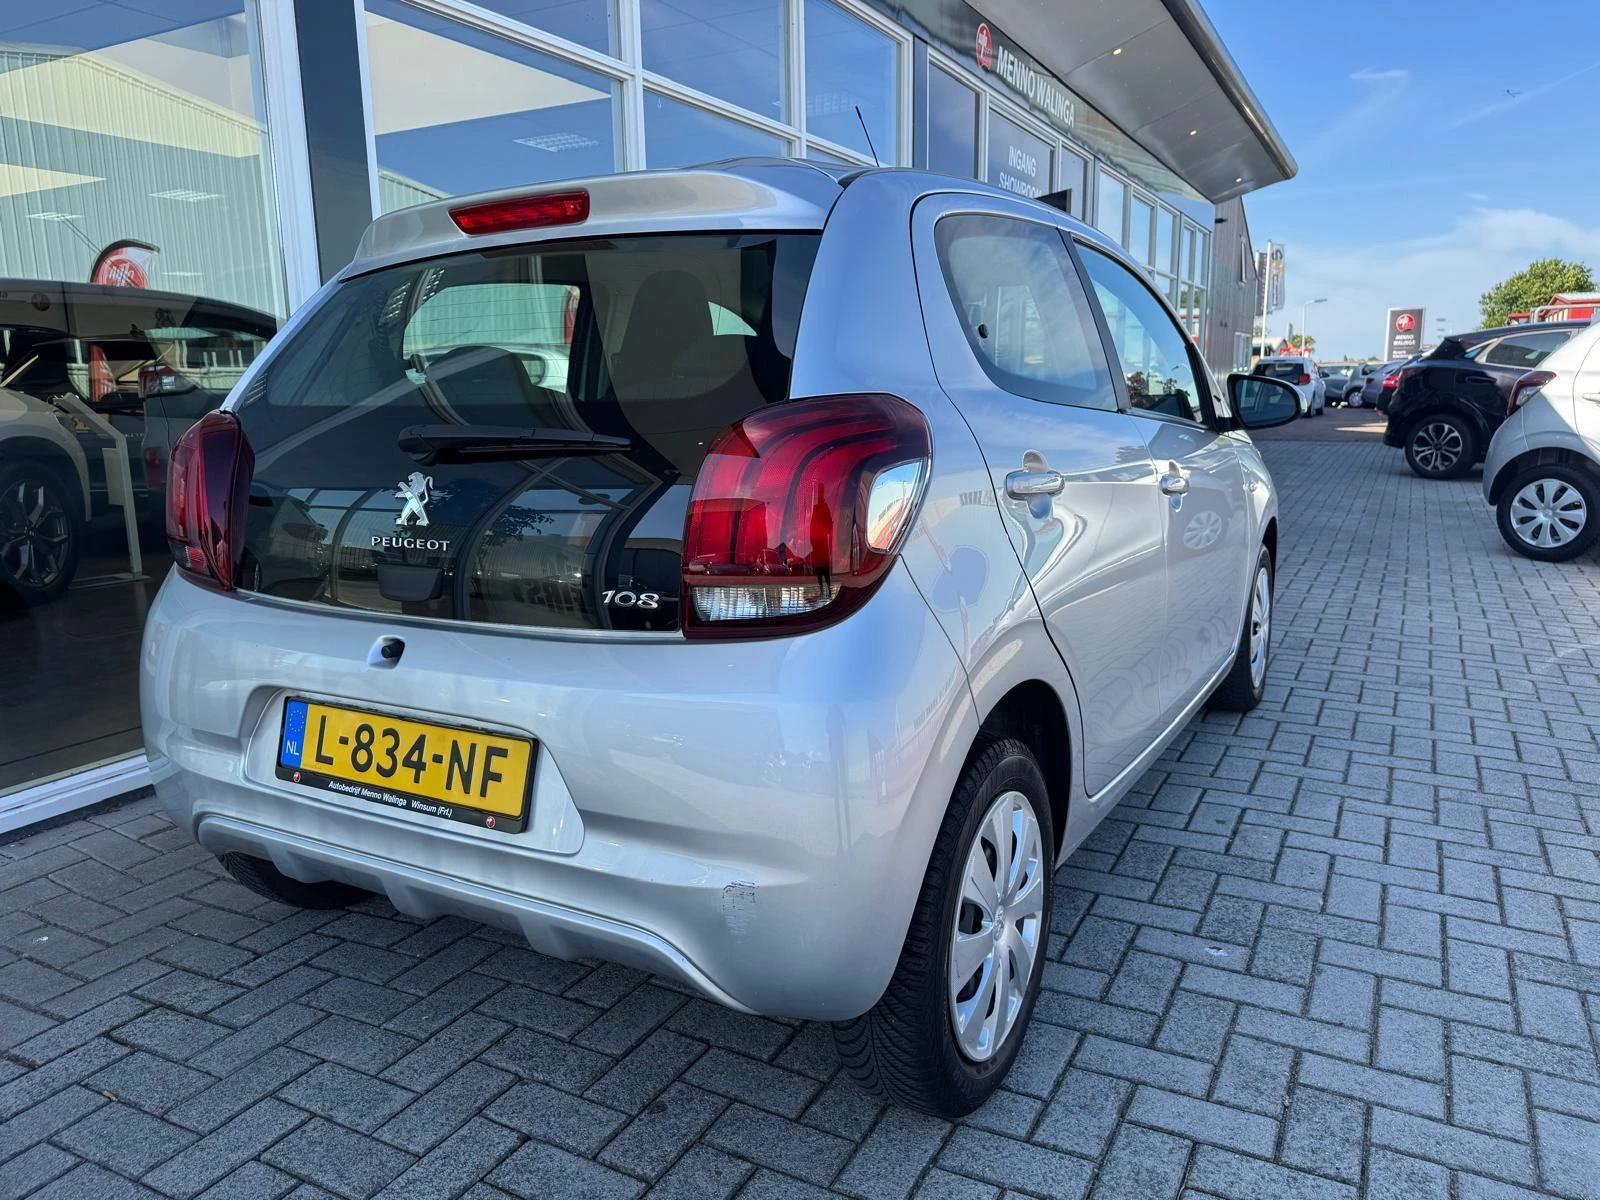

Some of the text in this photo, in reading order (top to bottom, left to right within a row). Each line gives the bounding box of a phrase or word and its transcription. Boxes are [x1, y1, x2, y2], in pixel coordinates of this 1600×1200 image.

[996, 45, 1075, 129] MENNO WALINGA
[1008, 145, 1036, 177] INGANG
[371, 535, 450, 552] PEUGEOT
[602, 590, 661, 609] 108
[285, 739, 300, 756] NL
[315, 715, 509, 798] L-834-NF
[328, 780, 361, 796] Autobedrijf
[361, 788, 382, 800] Menno
[383, 792, 407, 807] Walinga
[411, 799, 437, 814] Winsum
